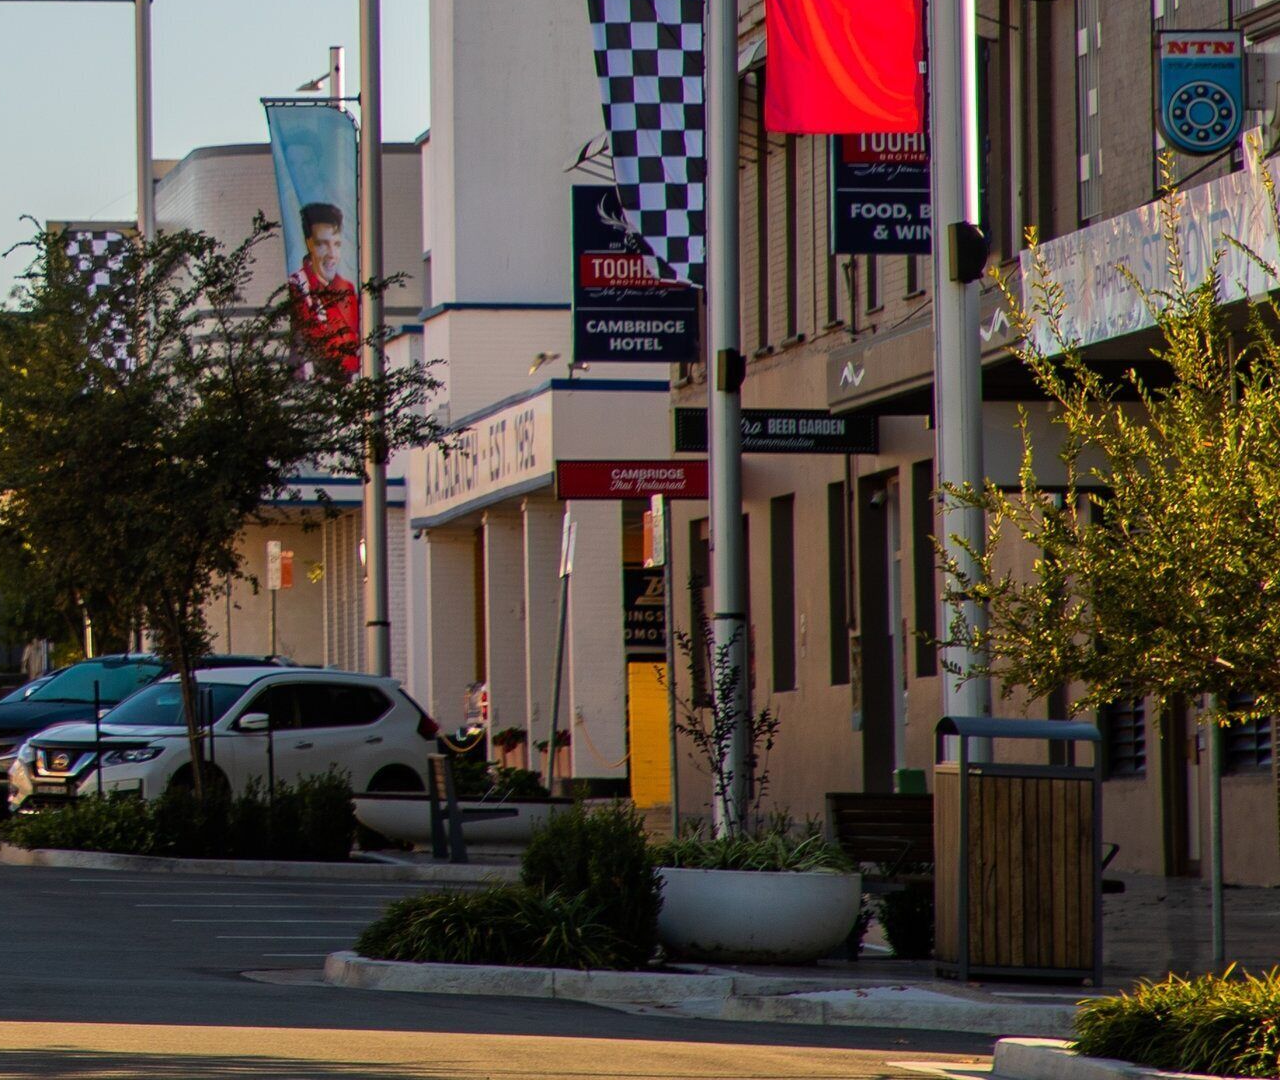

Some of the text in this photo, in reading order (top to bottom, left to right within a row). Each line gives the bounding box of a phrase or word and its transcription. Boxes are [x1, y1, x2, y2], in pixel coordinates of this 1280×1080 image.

[1167, 40, 1235, 55] NTN
[850, 203, 912, 222] FOOD,
[873, 224, 931, 241] & WIN
[585, 320, 686, 334] CAMBRIDGE
[609, 337, 663, 351] HOTEL
[767, 419, 797, 436] BEER
[798, 419, 846, 436] GARDEN
[611, 468, 686, 480] CAMBRIDGE
[609, 479, 687, 494] Thai Restaurant
